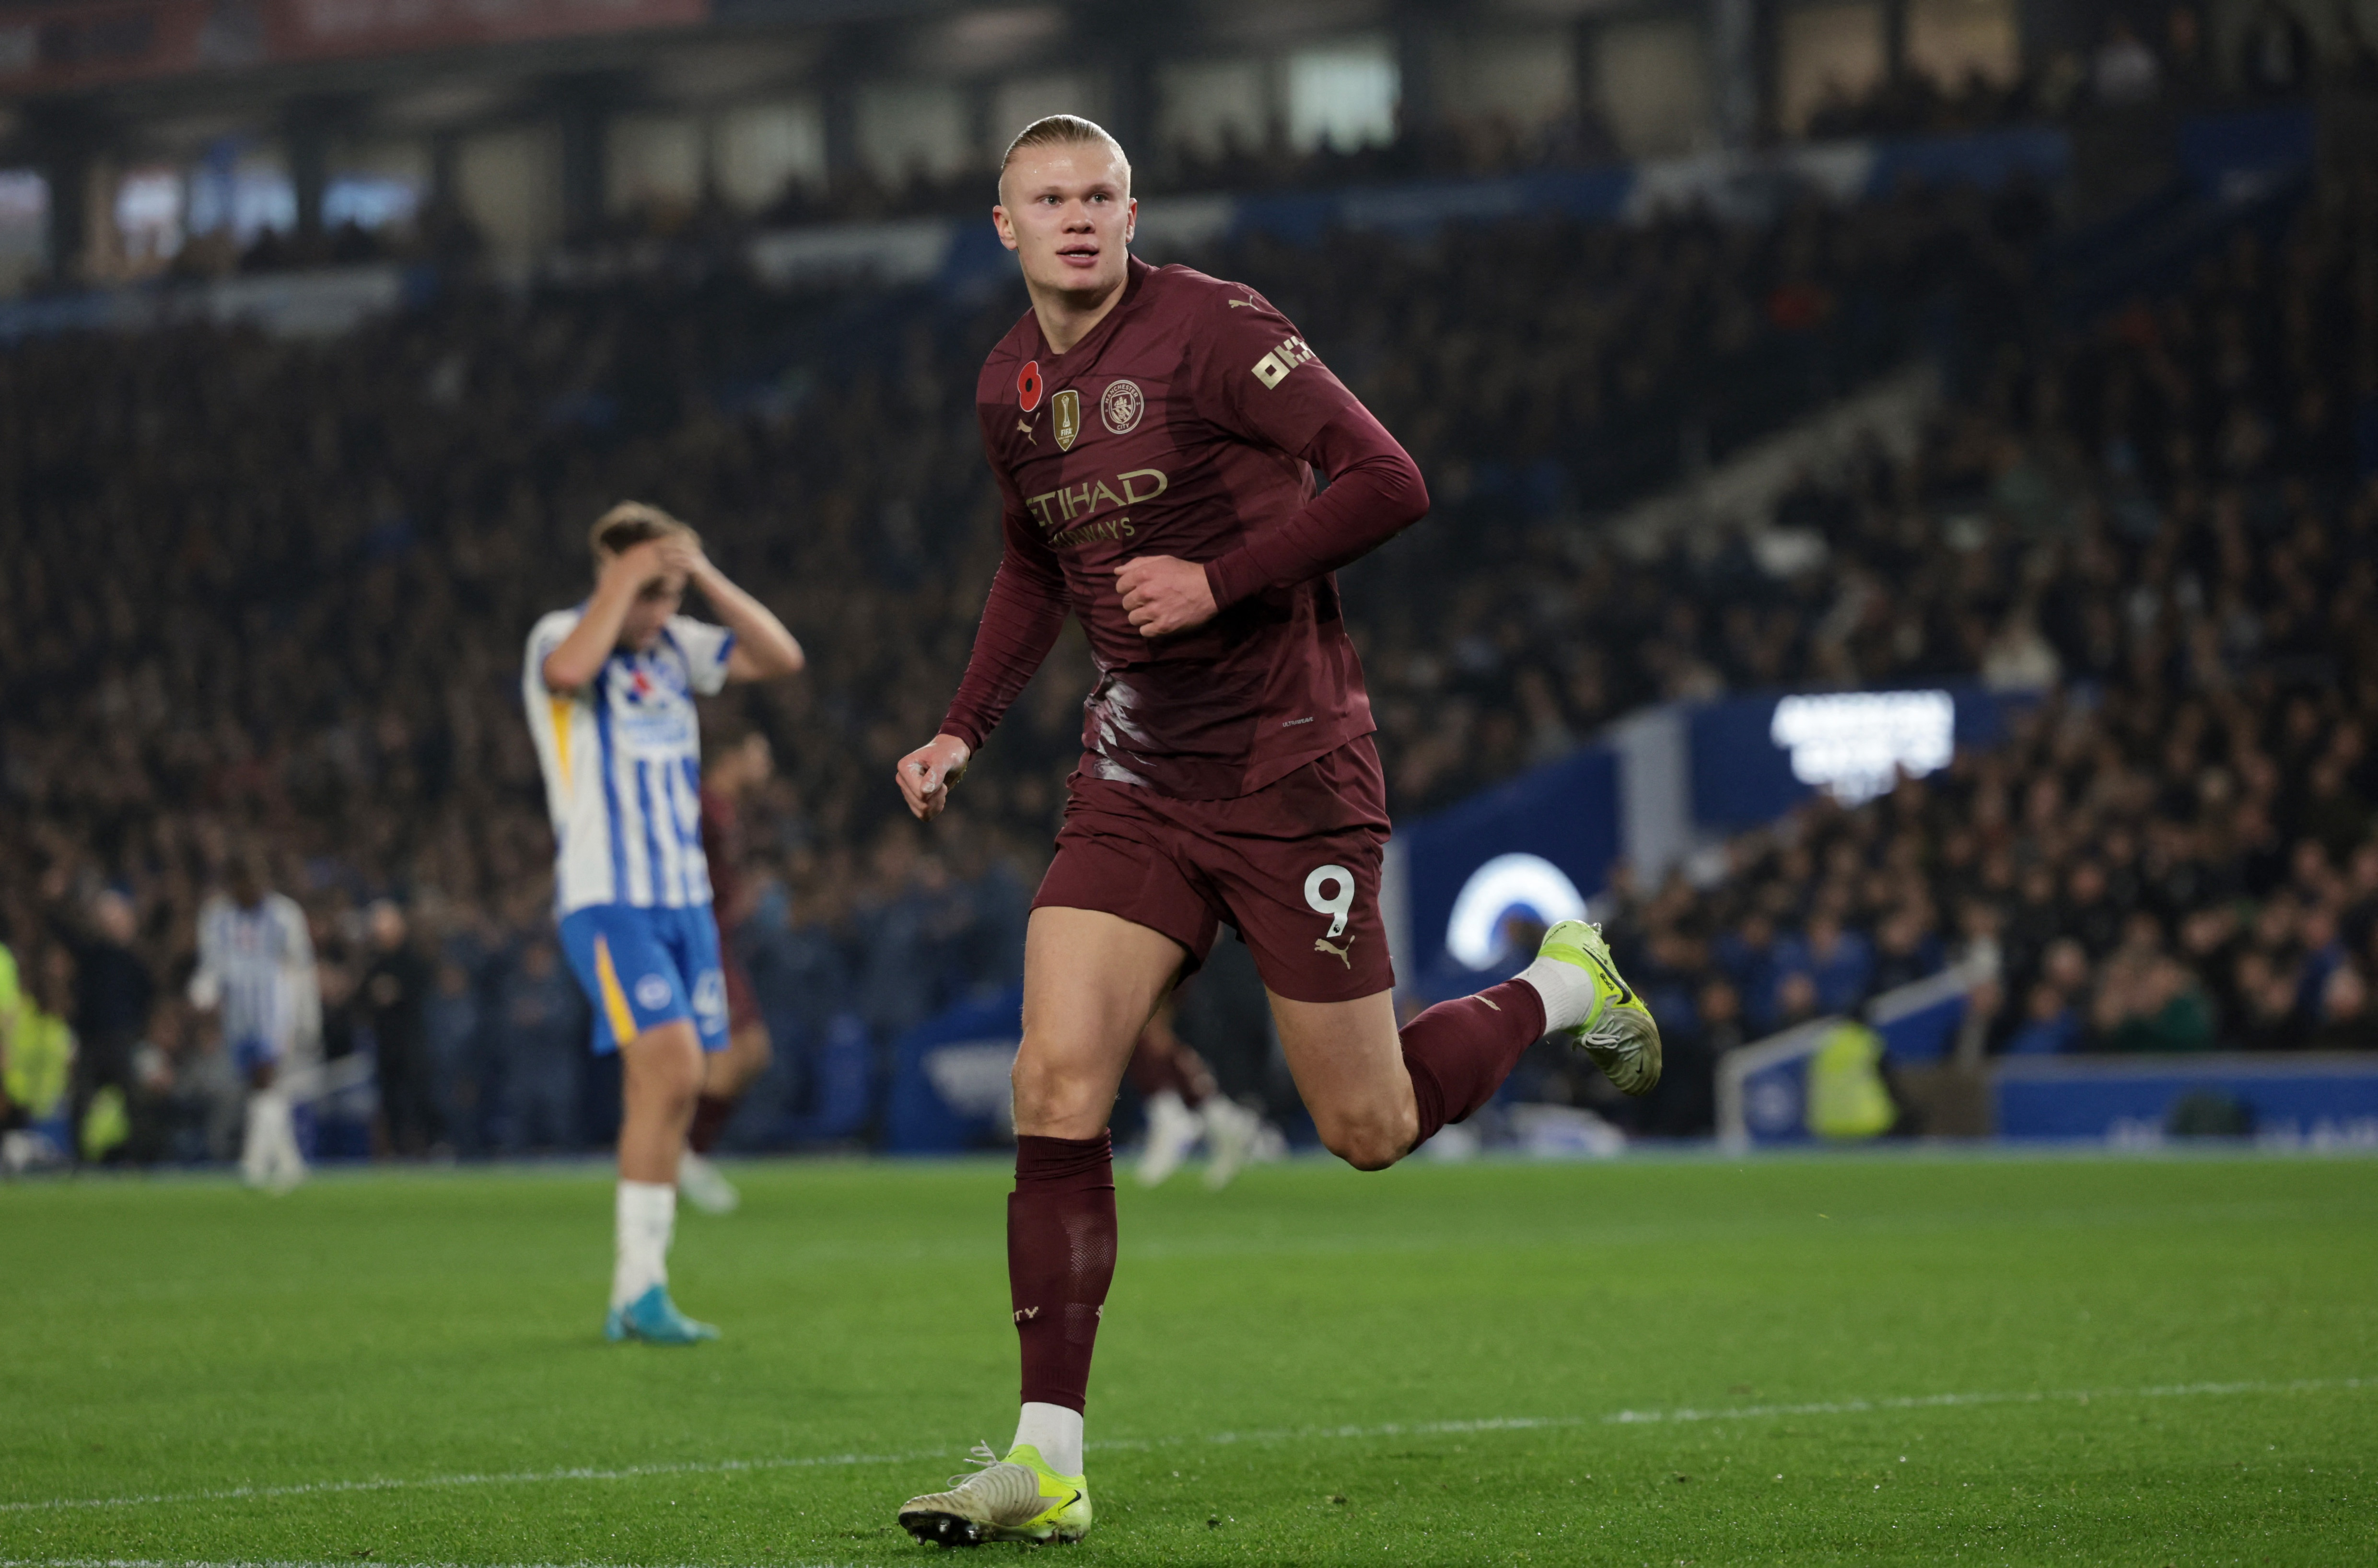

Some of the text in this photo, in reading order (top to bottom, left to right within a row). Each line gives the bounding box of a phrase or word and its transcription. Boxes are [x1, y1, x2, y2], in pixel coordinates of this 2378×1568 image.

[1105, 384, 1138, 404] MANCHESTER
[1061, 428, 1072, 436] FIFA
[1282, 717, 1314, 727] ULTRAWEAVE
[1305, 864, 1355, 938] 9
